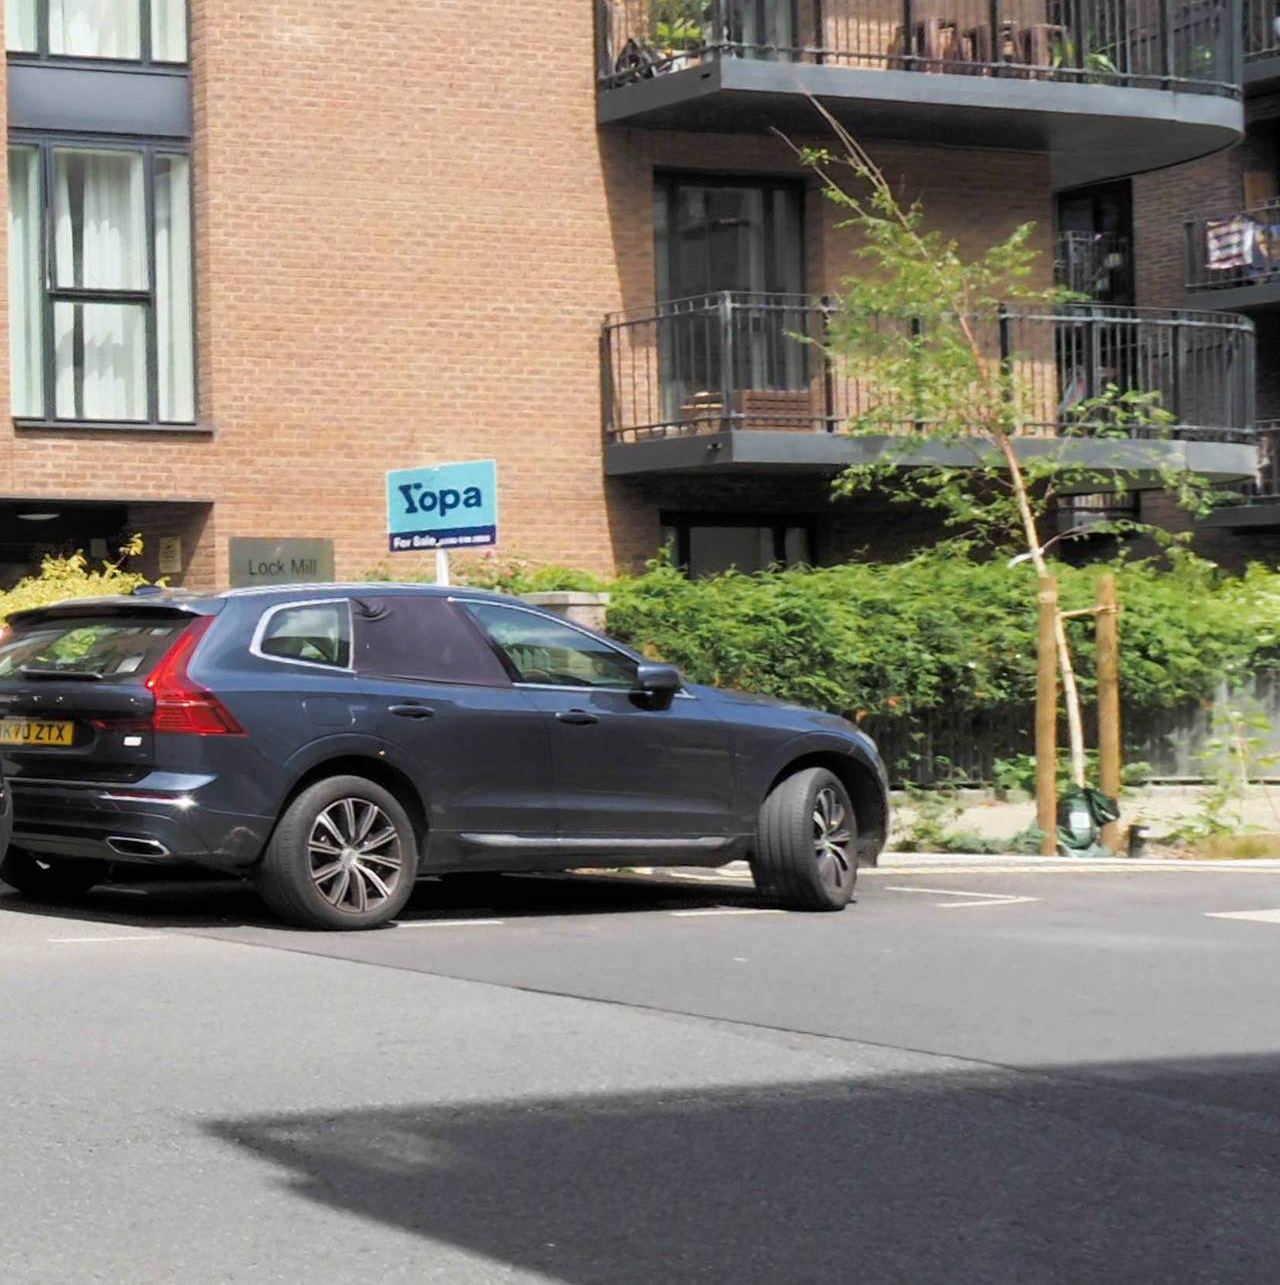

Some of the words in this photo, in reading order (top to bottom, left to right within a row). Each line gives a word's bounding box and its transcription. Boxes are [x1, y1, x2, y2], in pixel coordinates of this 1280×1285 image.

[398, 482, 482, 517] Yopa
[393, 536, 412, 548] For
[248, 558, 285, 576] Lock
[290, 558, 317, 575] Mill
[35, 723, 66, 742] ZTX
